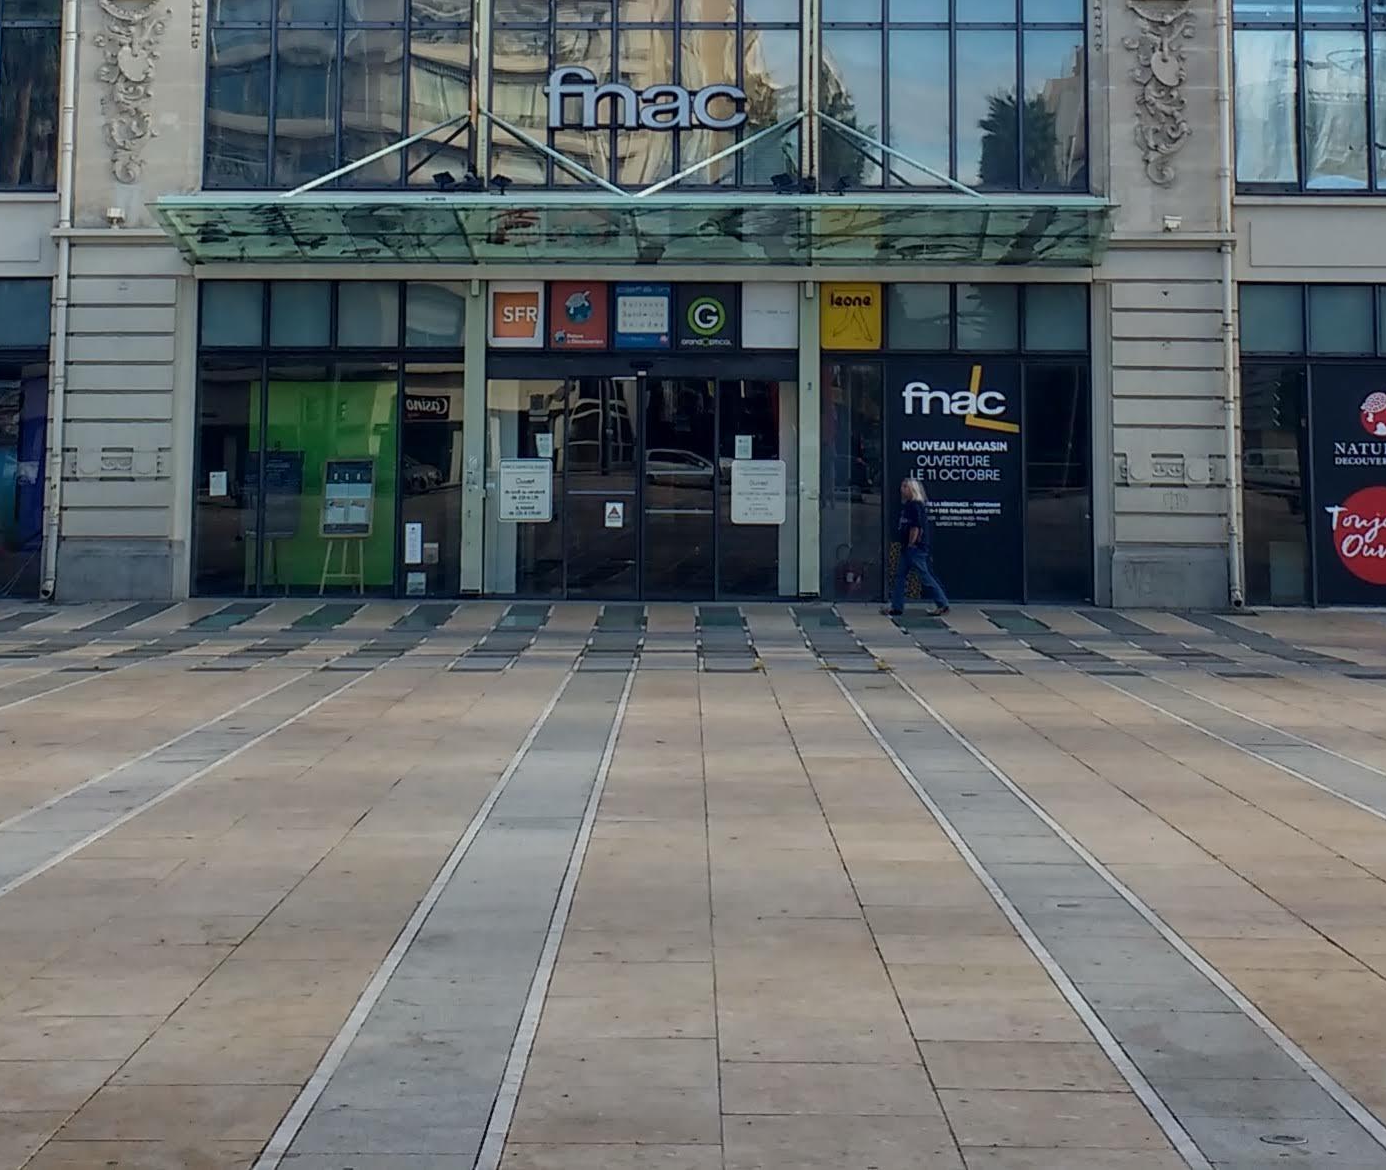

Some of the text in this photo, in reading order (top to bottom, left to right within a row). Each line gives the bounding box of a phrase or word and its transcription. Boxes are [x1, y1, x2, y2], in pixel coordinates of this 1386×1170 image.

[544, 65, 748, 129] fnac
[502, 306, 538, 322] SFR
[901, 381, 1007, 416] fnac
[901, 440, 1008, 452] NOUVEAU MAGASIN
[916, 454, 991, 467] OUVERTURE
[910, 469, 1001, 481] LE 11 OCTOBRE
